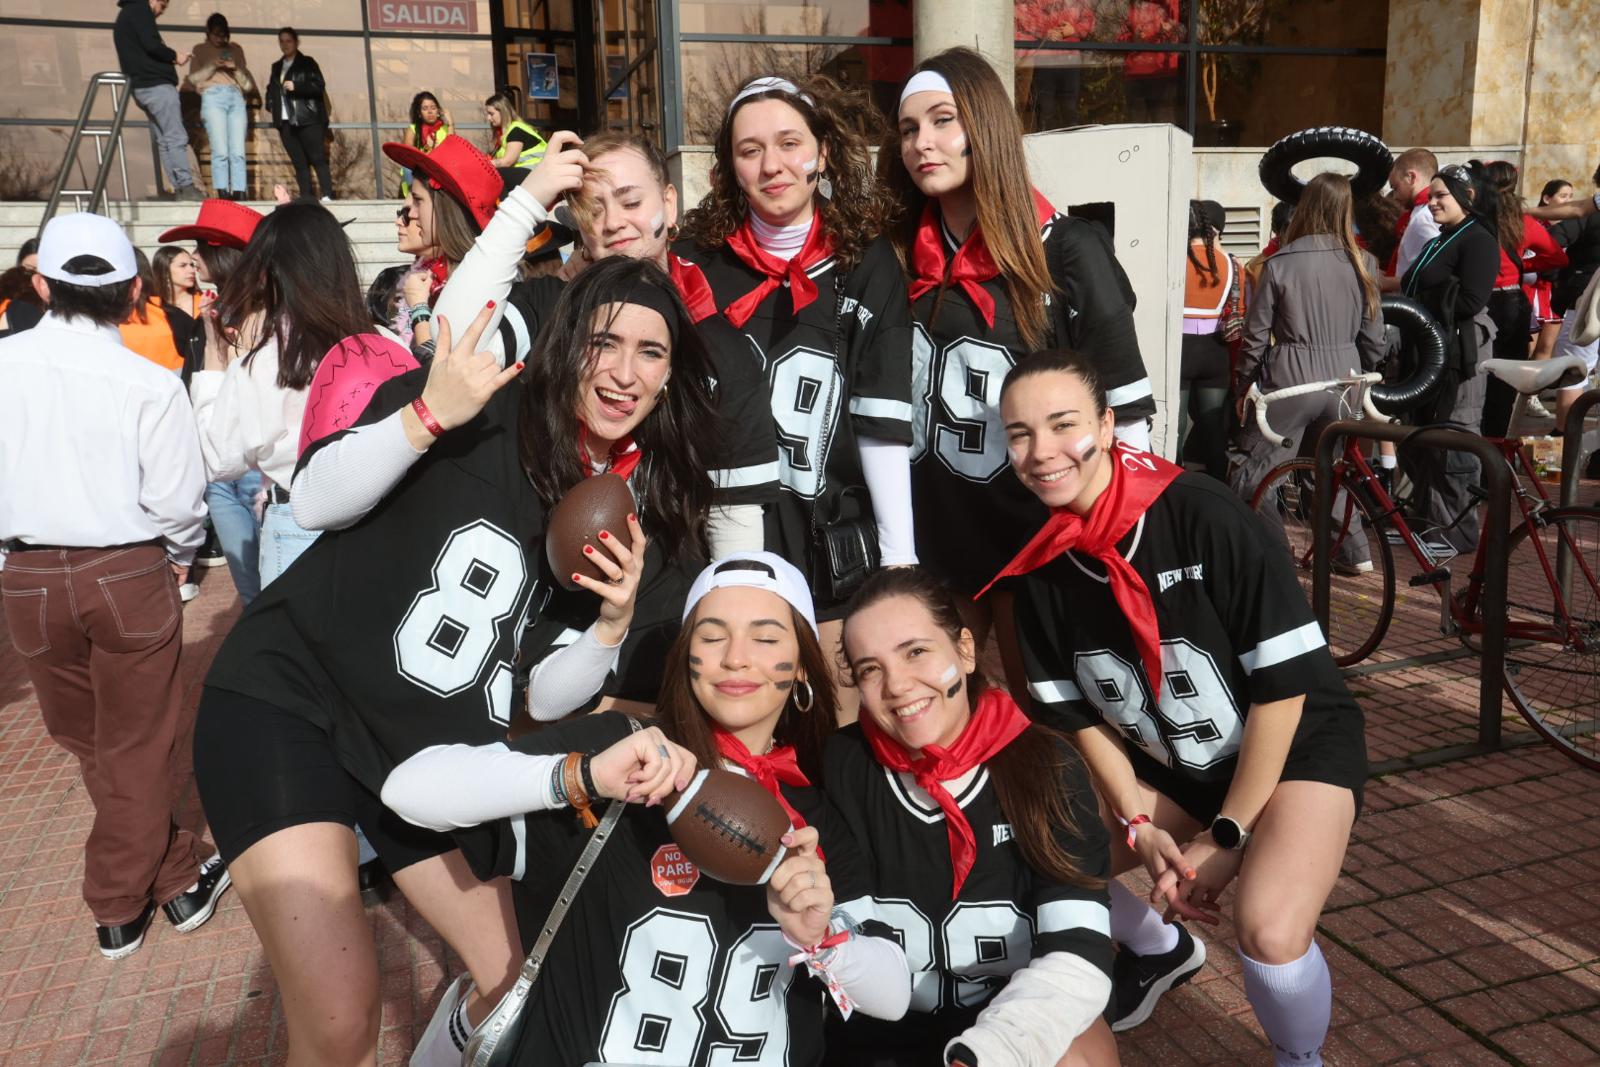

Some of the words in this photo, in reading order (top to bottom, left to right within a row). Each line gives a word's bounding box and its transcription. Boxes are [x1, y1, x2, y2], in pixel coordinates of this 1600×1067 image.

[382, 3, 465, 25] SALIDA
[840, 296, 859, 315] NE
[745, 334, 845, 500] 9
[1157, 568, 1183, 593] NEW
[393, 518, 527, 727] 8
[1073, 637, 1246, 770] 89
[665, 851, 681, 862] NO
[657, 862, 693, 878] PARE
[599, 907, 797, 1067] 89
